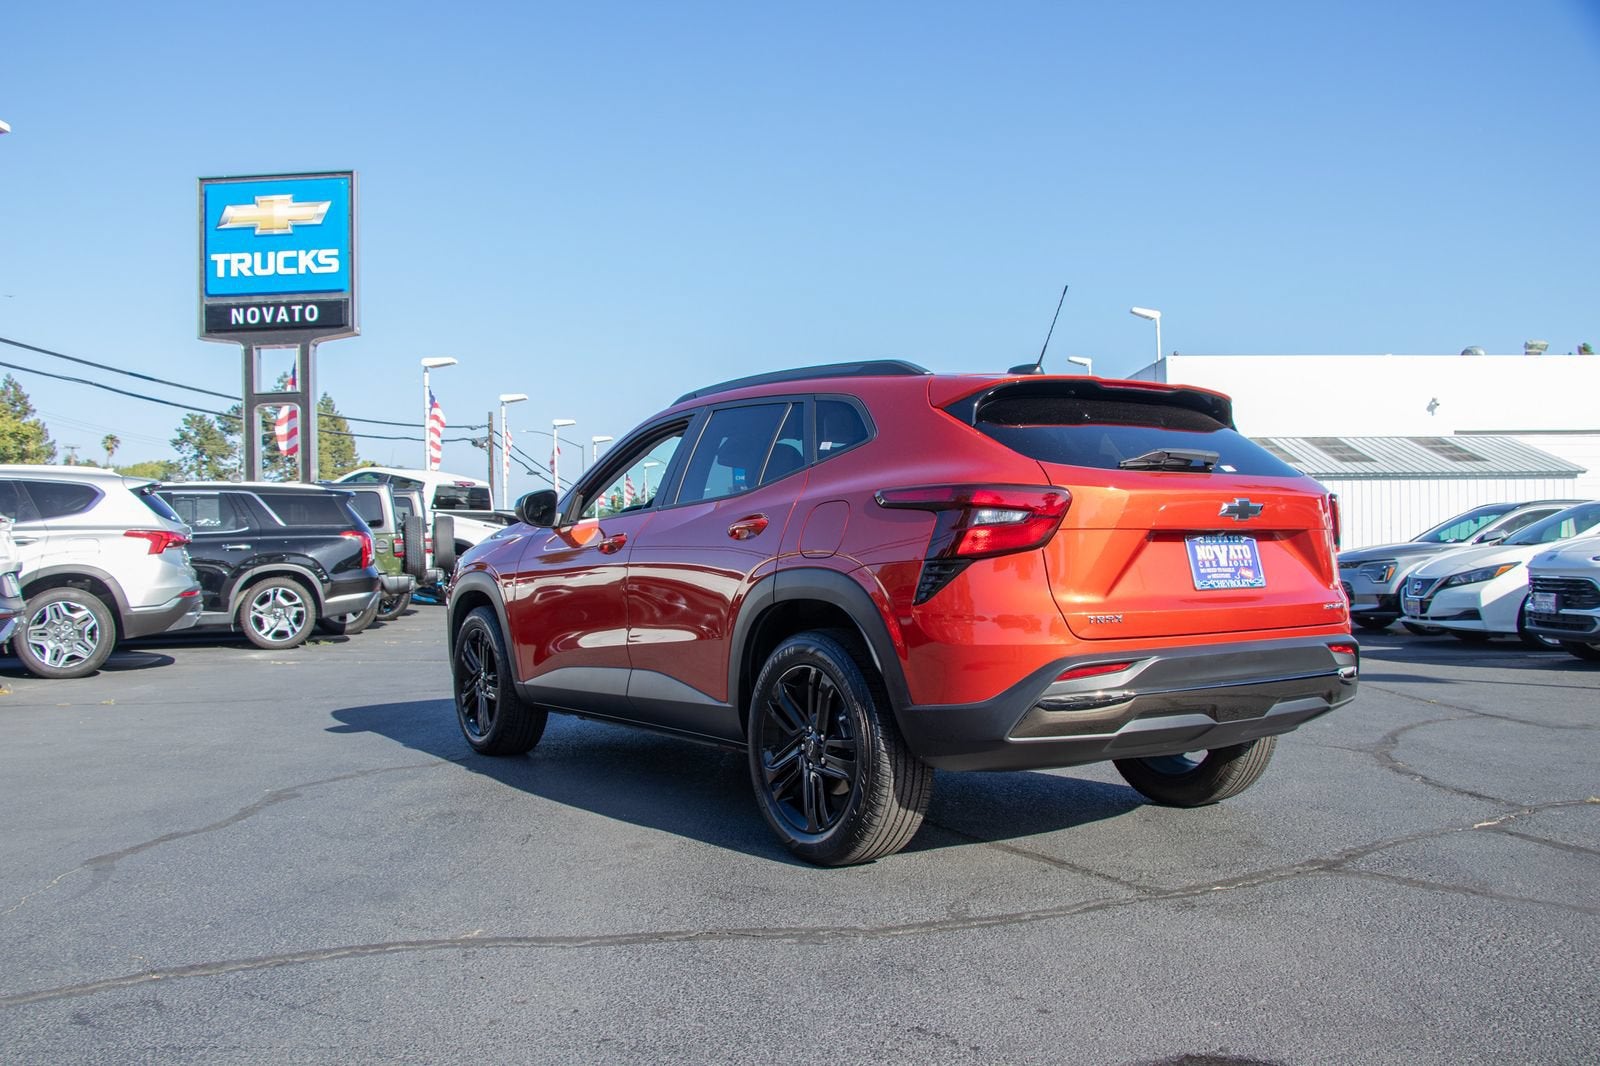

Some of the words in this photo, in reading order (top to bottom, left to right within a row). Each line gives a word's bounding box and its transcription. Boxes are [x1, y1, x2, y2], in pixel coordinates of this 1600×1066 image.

[211, 249, 340, 277] TRUCKS
[231, 305, 319, 324] NOVATO
[1195, 545, 1252, 567] NOVATO
[1088, 615, 1123, 624] TRAX
